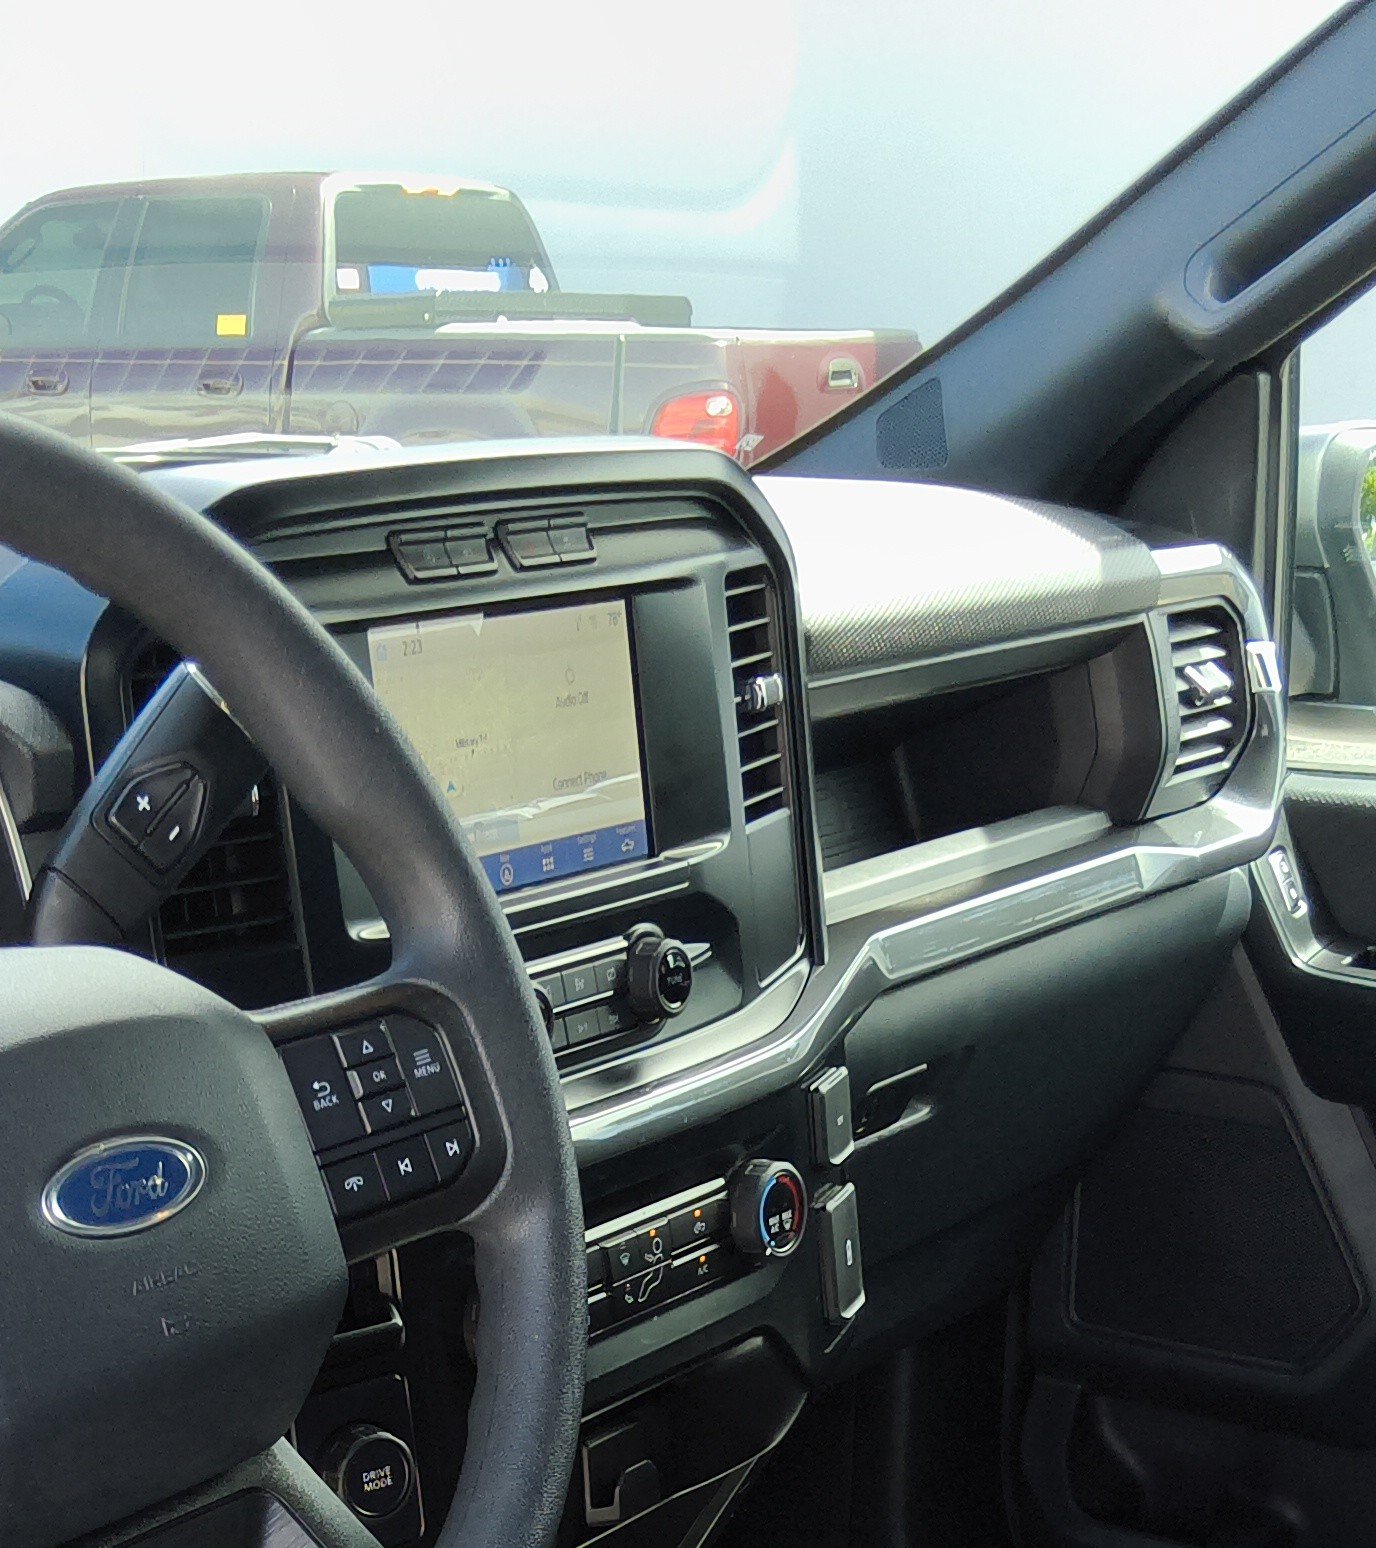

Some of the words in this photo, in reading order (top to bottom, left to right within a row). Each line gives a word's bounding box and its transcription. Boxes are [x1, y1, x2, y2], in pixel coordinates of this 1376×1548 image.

[373, 1070, 387, 1082] OK
[414, 1062, 441, 1079] MENU
[312, 1094, 340, 1111] BACK
[89, 1156, 169, 1218] Ford
[363, 1465, 391, 1483] DRIVE
[364, 1476, 393, 1492] MODE
